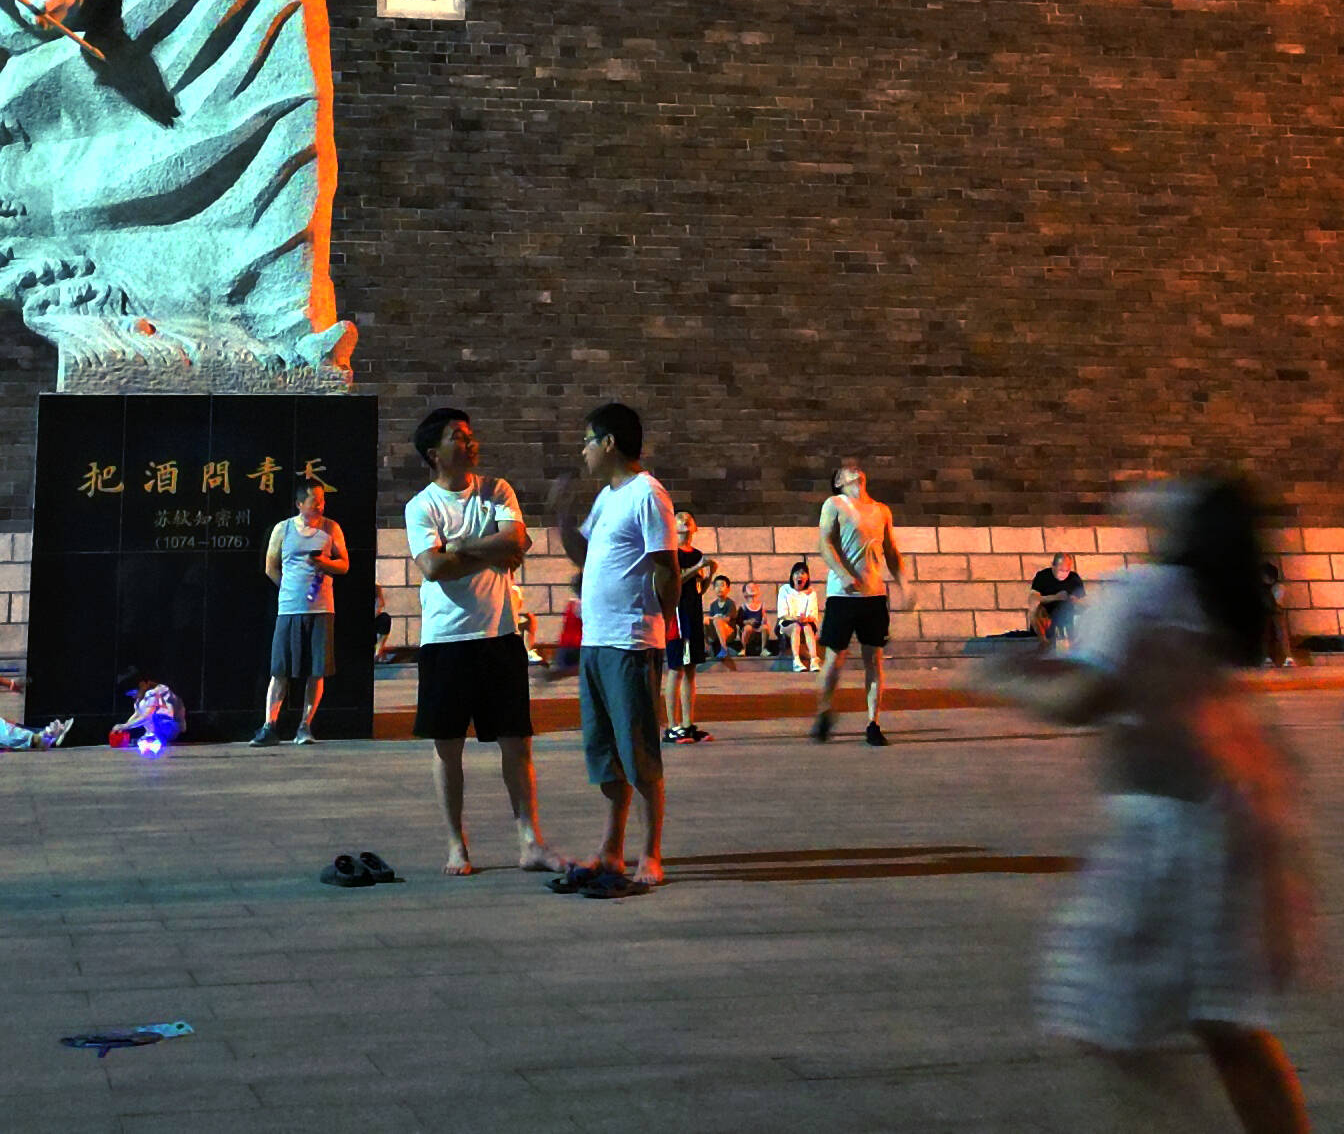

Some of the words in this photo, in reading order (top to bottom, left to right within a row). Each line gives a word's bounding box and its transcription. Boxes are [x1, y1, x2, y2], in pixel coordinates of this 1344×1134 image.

[77, 456, 338, 497] 把酒問青天
